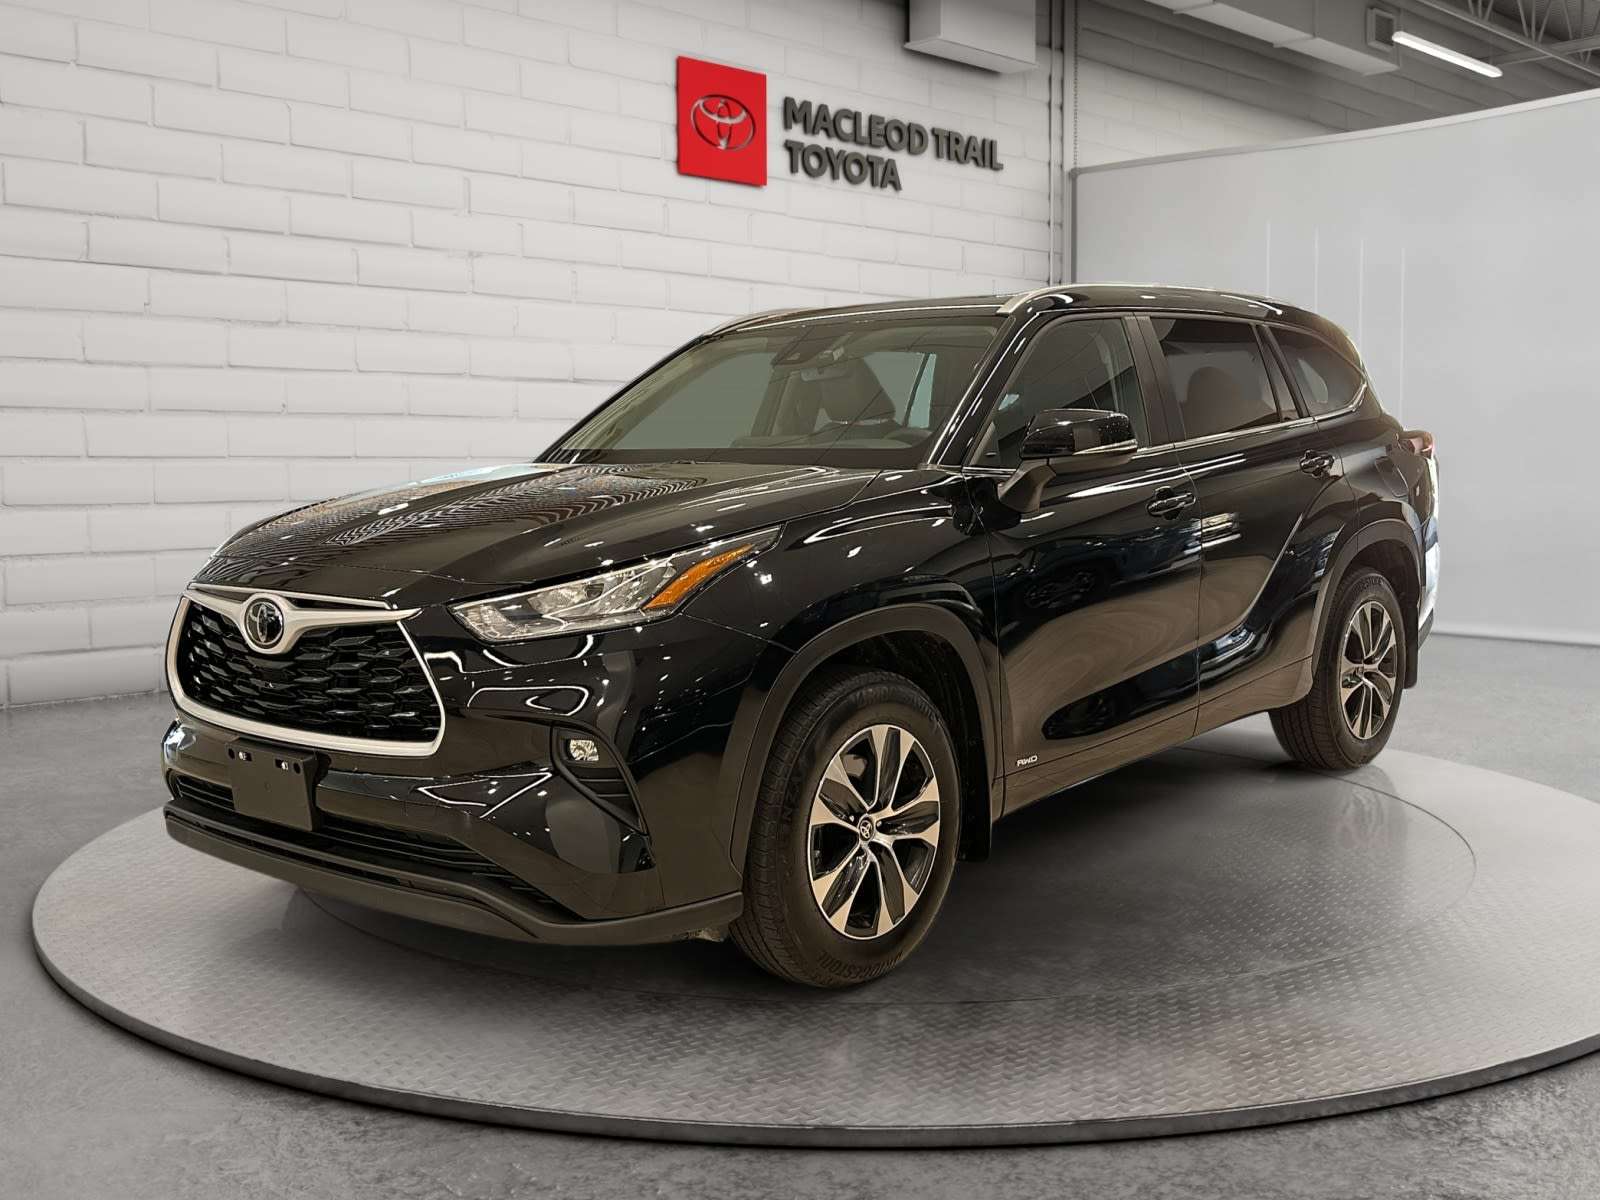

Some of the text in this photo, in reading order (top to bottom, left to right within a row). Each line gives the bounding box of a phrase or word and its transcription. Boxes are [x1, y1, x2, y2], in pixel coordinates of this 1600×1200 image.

[783, 96, 1004, 171] MACLEOD TRAIL
[784, 139, 902, 191] TOYOTA
